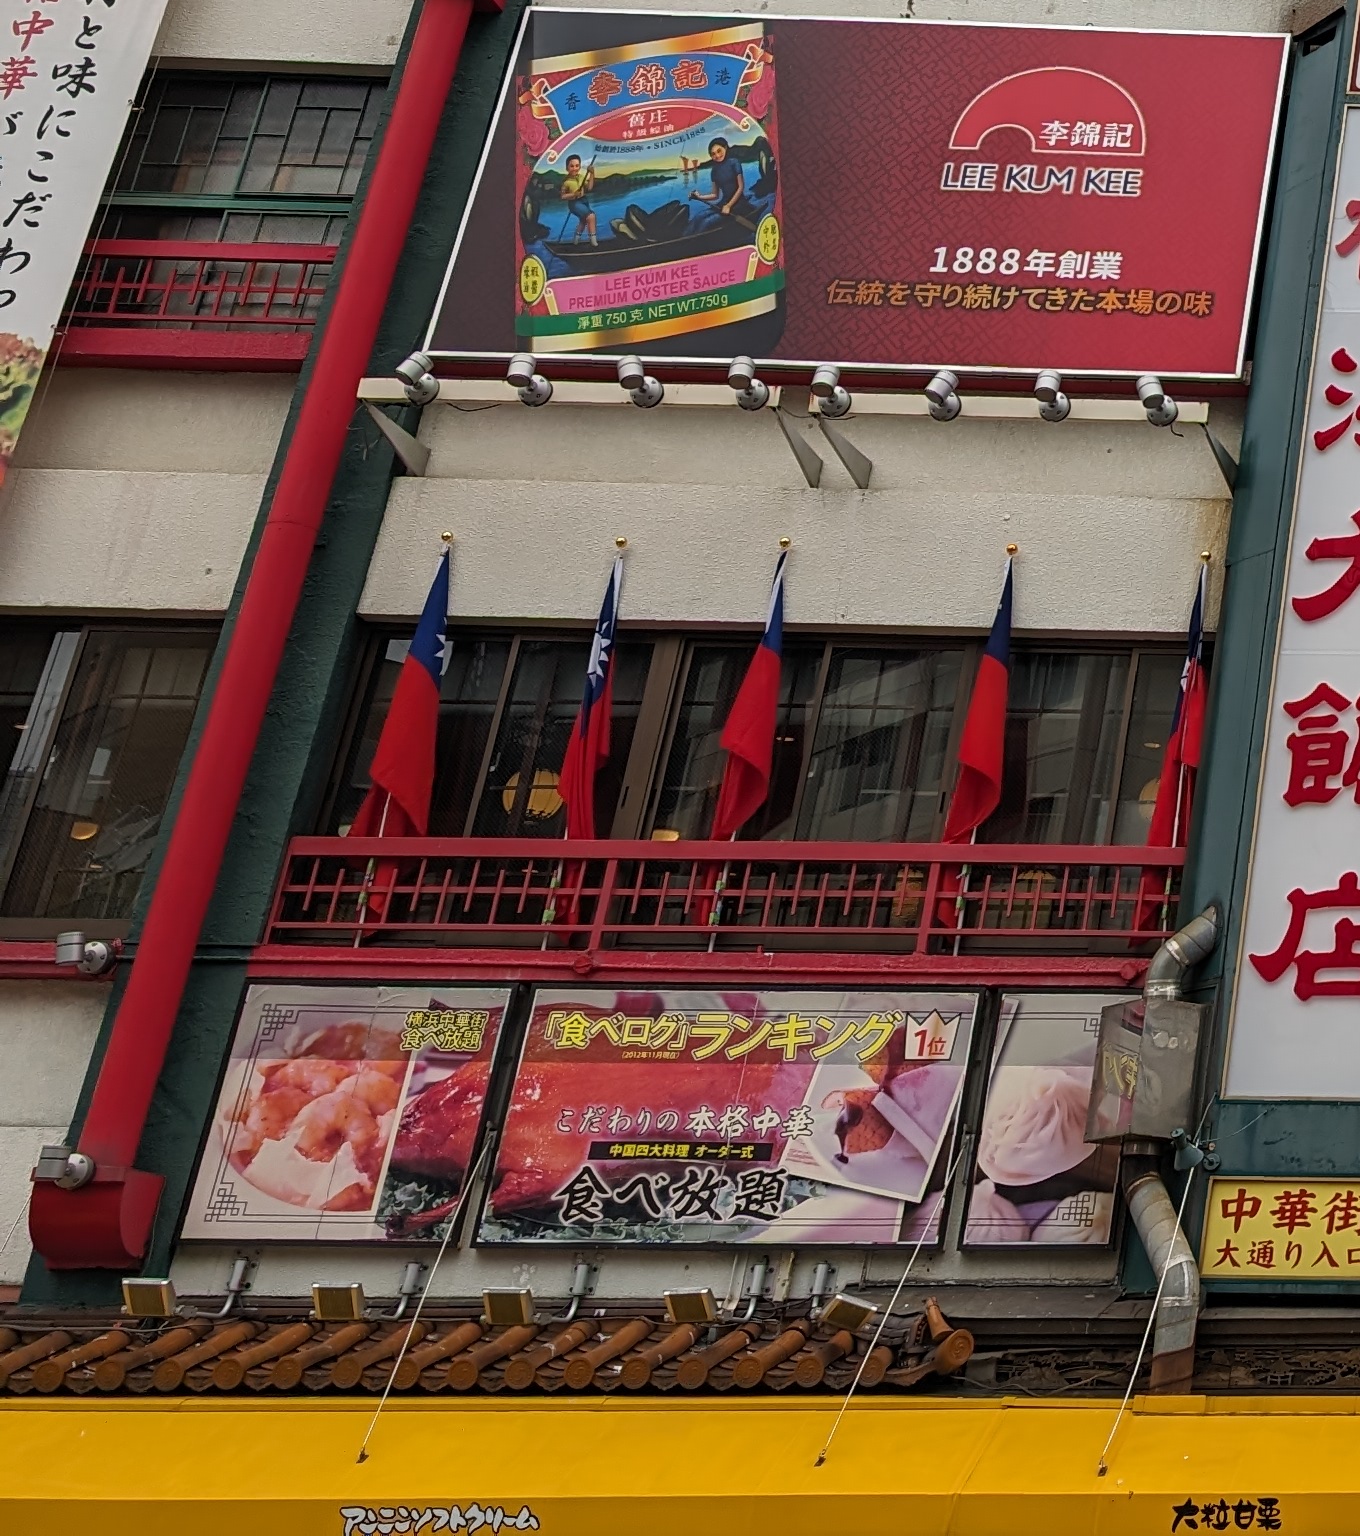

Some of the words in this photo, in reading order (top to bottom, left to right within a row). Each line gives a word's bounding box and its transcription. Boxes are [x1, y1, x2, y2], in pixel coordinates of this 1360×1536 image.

[1040, 119, 1134, 150] 李錦記
[941, 162, 995, 193] LEE
[1004, 164, 1074, 195] KUM
[1083, 167, 1143, 197] KEE
[605, 277, 631, 292] LEE
[635, 270, 667, 289] KUM
[670, 264, 699, 282] KEE
[930, 246, 1124, 280] 1888年創業
[568, 292, 628, 310] PREMIUM
[631, 280, 692, 301] OYSTER
[693, 269, 737, 289] SAUCE
[826, 279, 1213, 318] 伝統を守り続けてきた本場の味
[648, 303, 676, 320] NET
[404, 1010, 488, 1029] 横浜中華街
[402, 1027, 483, 1050] 食べ放題
[553, 1162, 789, 1224] 食べ放題
[1171, 1497, 1283, 1532] 大粒甘栗
